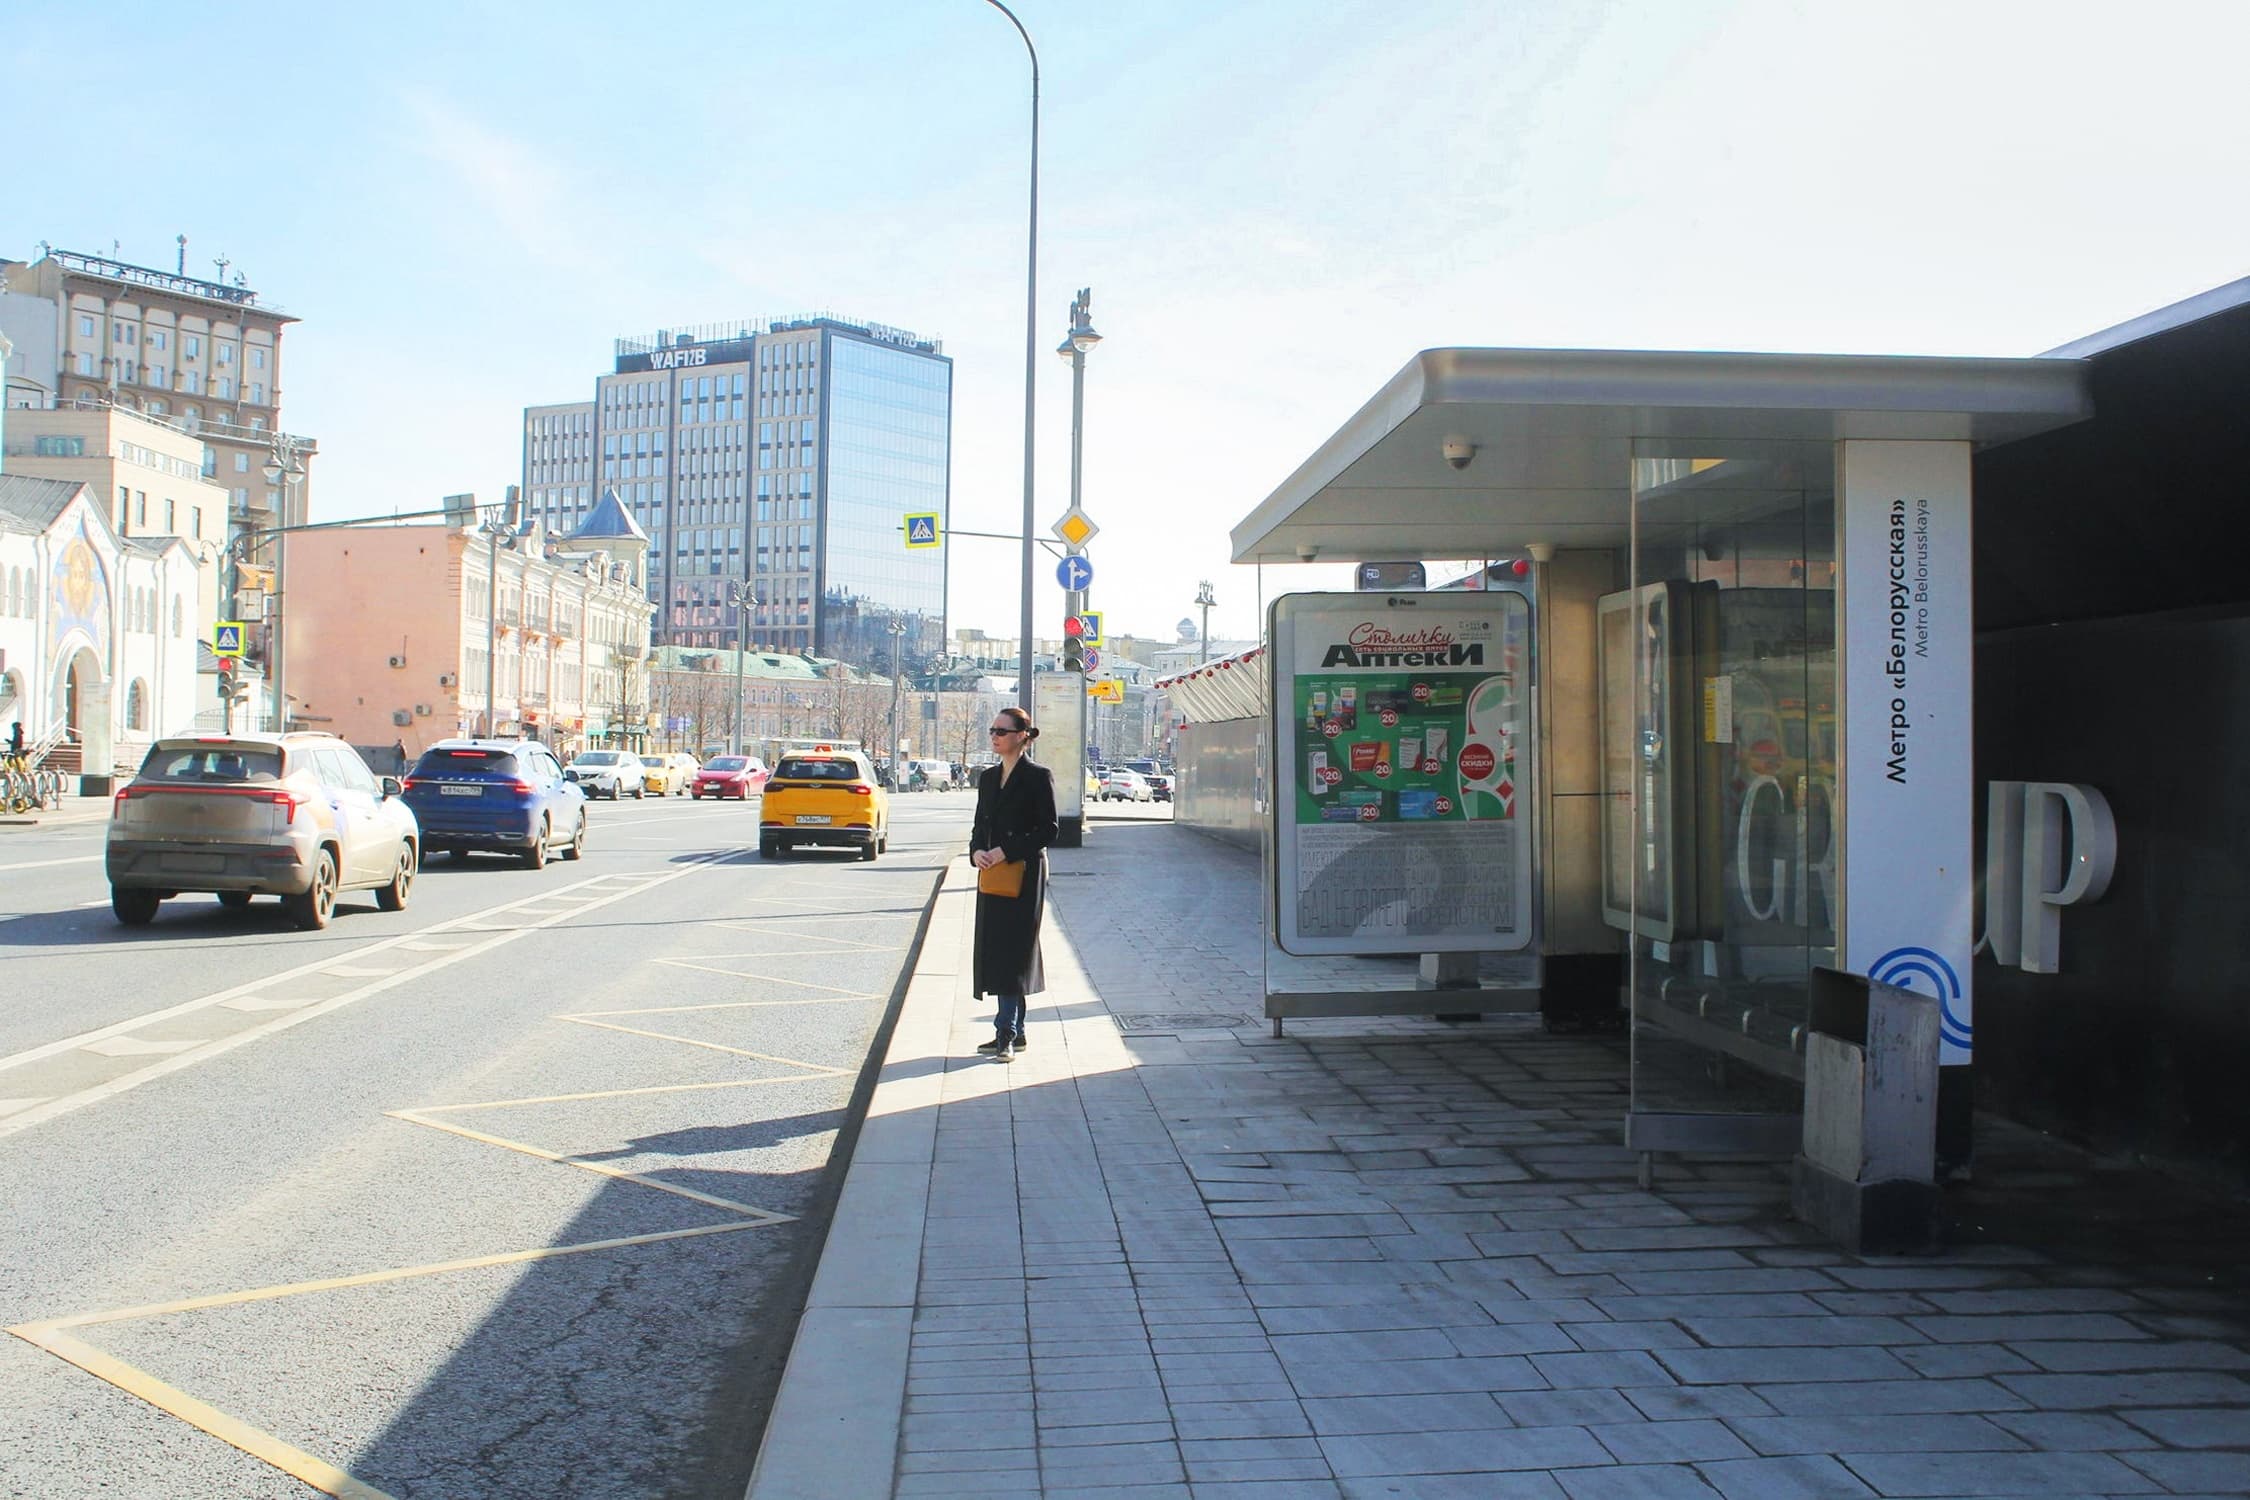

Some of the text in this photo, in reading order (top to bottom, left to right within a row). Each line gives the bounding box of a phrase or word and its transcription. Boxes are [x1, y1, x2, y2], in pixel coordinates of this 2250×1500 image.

[1914, 499, 1930, 658] Metro Belorusskaya
[1886, 500, 1910, 784] Метро «Белорусская»
[1414, 687, 1427, 697] 20
[1382, 713, 1395, 723] 20
[1325, 724, 1338, 734] 20
[1376, 765, 1389, 774] 20
[1425, 762, 1438, 771] 20
[1325, 771, 1338, 780] 20
[1436, 800, 1449, 810] 20
[1363, 807, 1376, 816] 20
